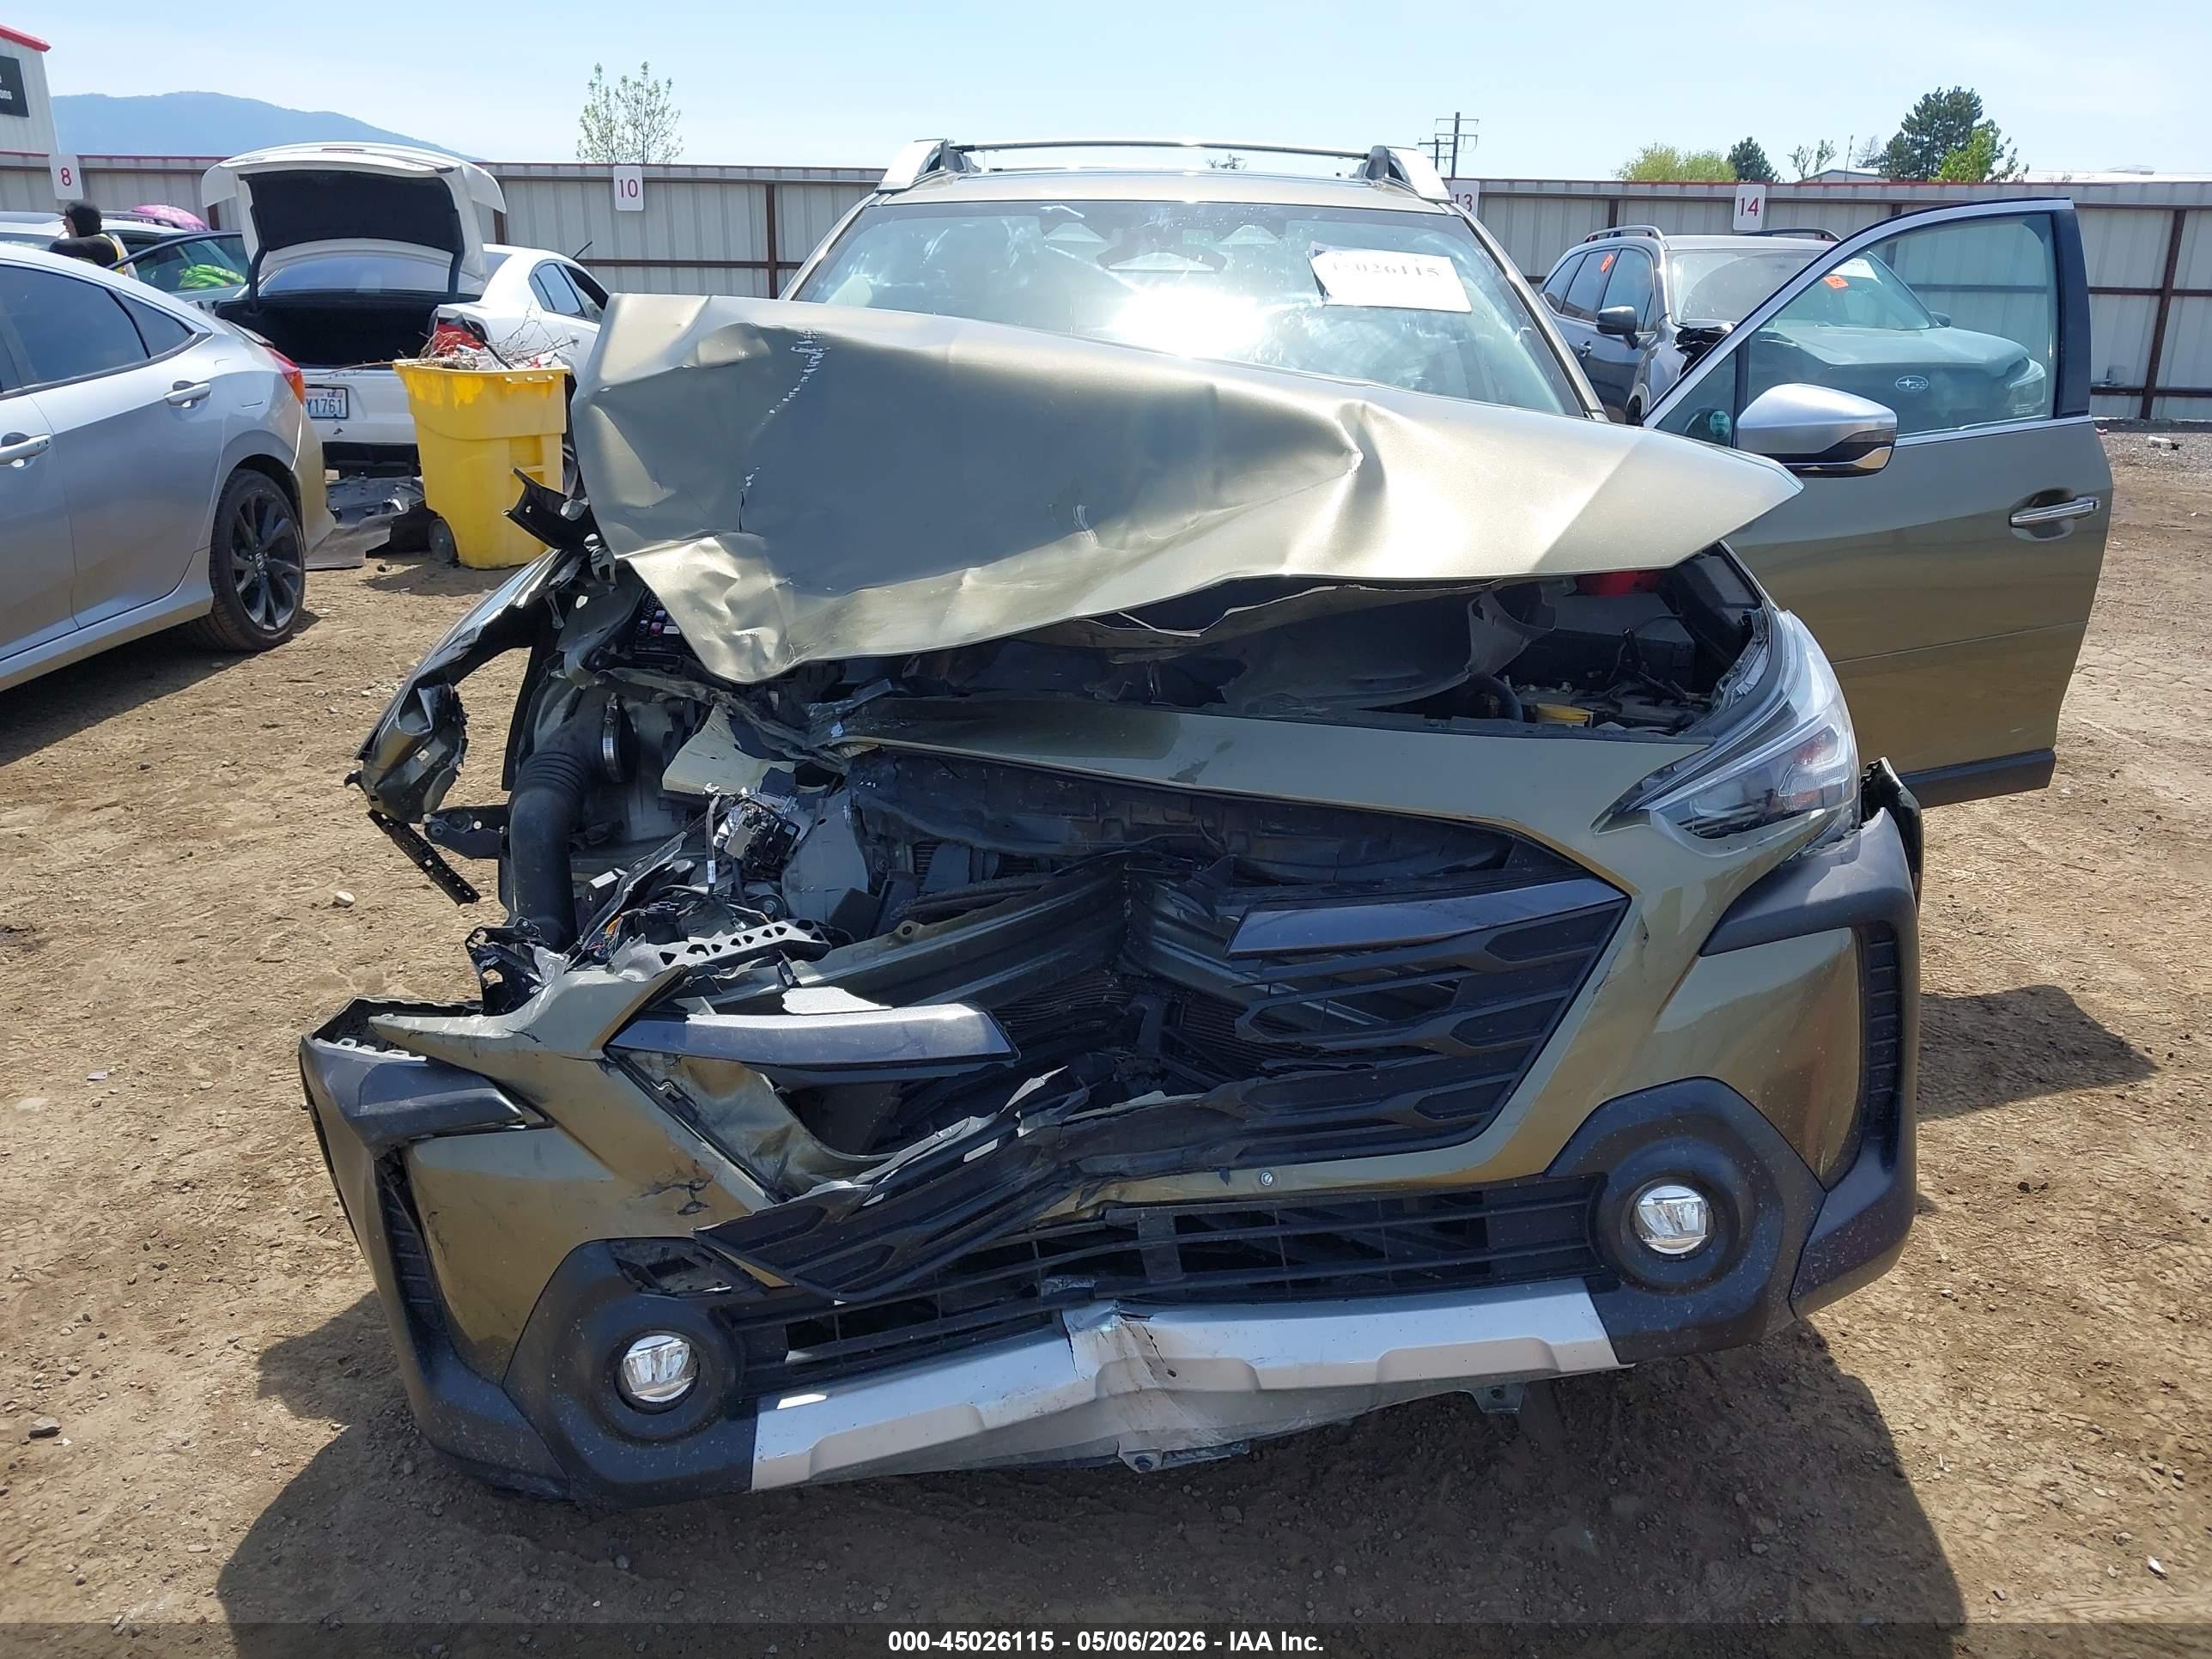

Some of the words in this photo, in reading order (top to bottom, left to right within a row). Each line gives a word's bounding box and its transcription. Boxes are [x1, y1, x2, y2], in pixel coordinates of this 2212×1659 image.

[60, 167, 72, 186] 8
[618, 178, 639, 198] 10
[1455, 193, 1474, 212] 13
[1739, 197, 1759, 217] 14
[306, 398, 343, 414] Y1761
